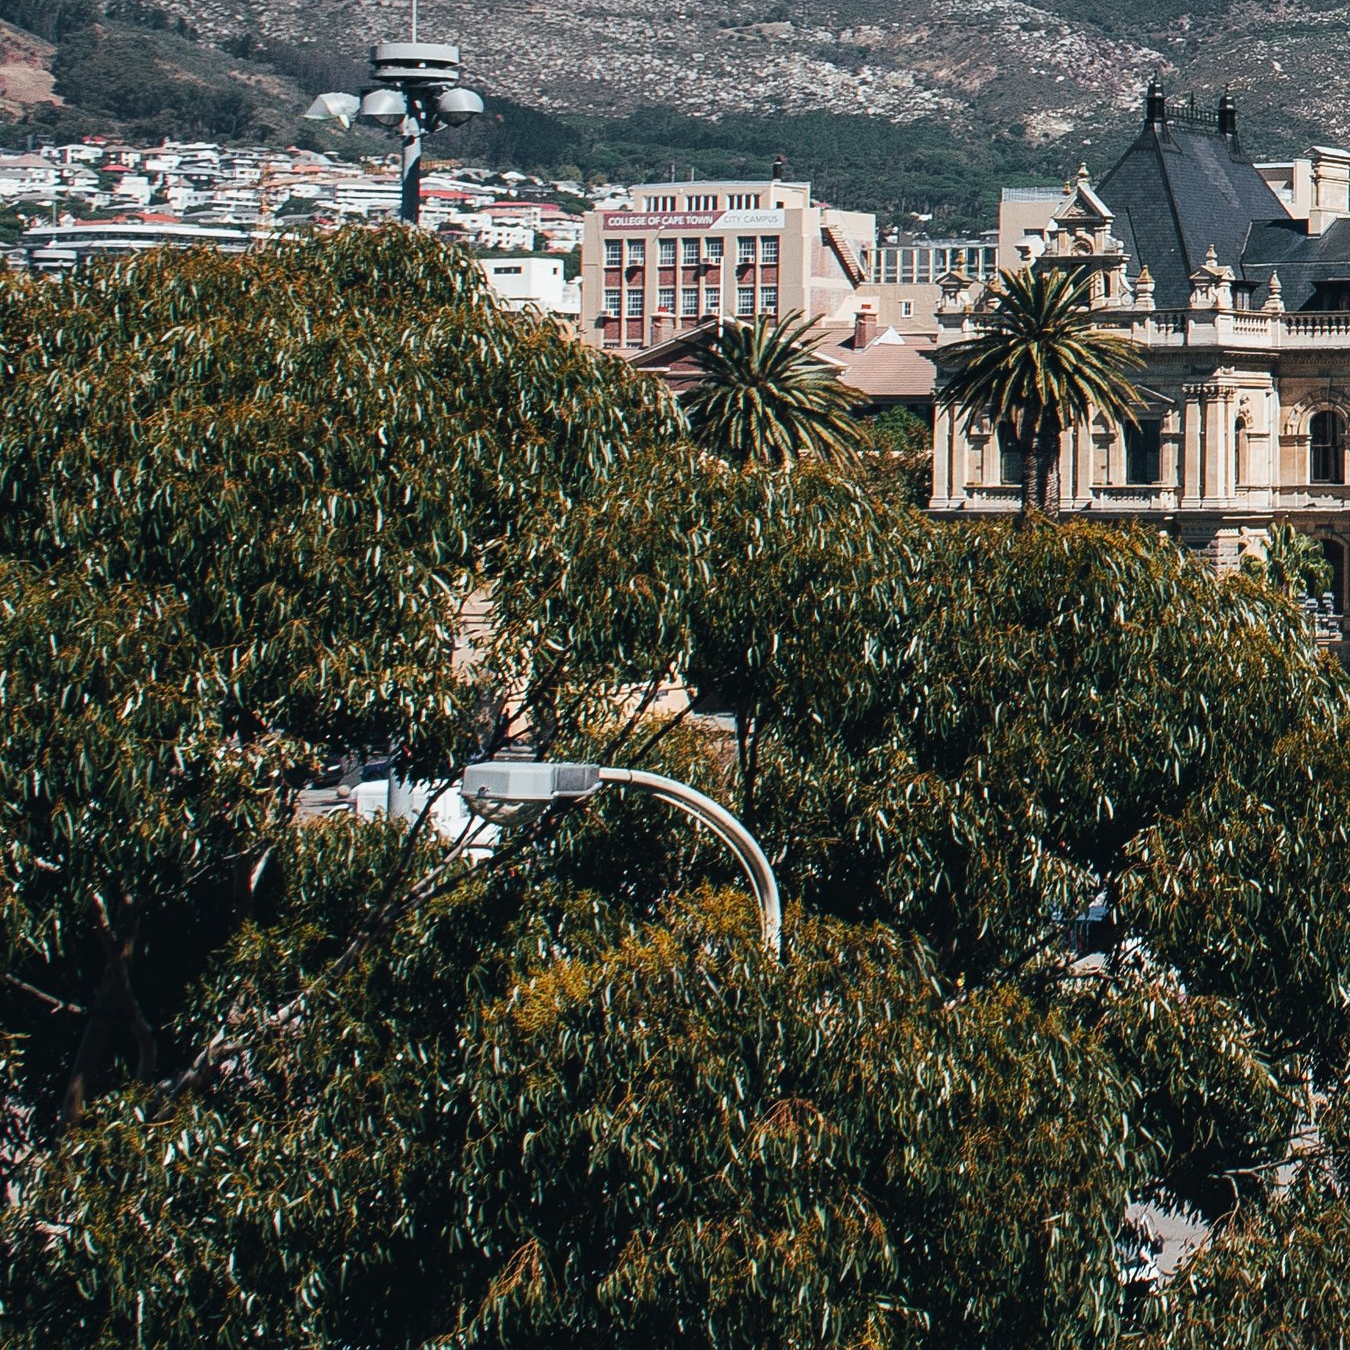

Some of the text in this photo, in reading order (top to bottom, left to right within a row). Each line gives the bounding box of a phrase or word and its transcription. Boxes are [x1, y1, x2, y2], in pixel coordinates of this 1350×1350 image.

[608, 214, 778, 226] COLLEGE OF CAPE TOWN CITY CAMPUS
